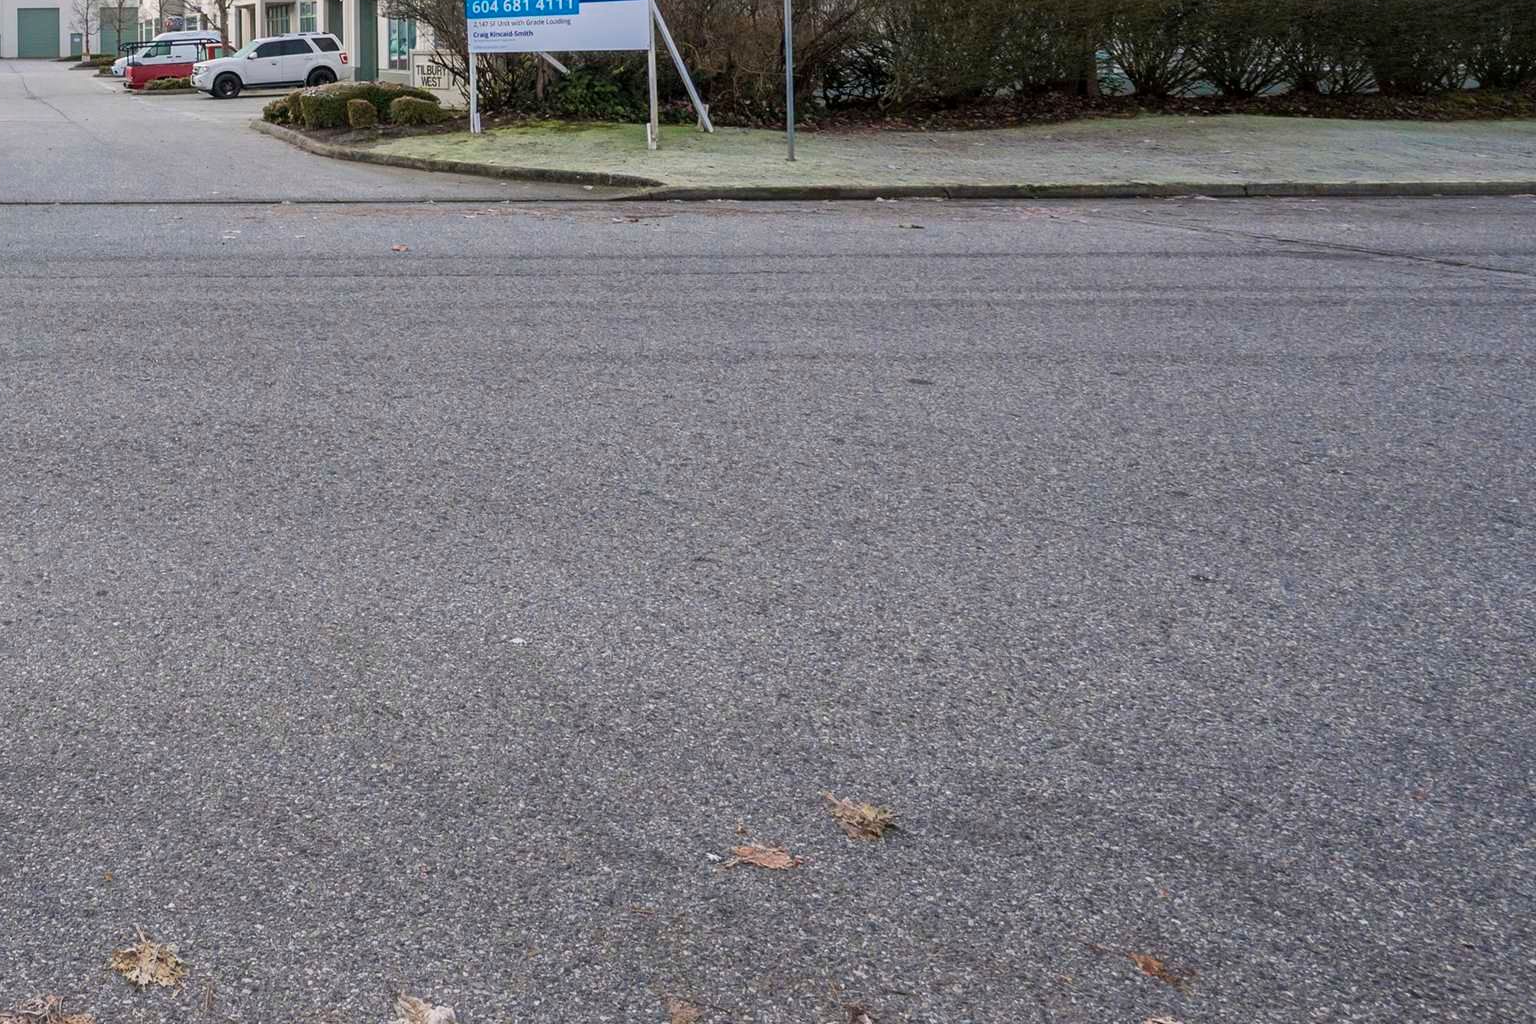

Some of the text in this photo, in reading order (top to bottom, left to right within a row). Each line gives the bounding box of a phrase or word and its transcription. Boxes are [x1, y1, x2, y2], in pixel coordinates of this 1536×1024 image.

[472, 0, 499, 14] 604
[526, 18, 545, 26] Grade
[546, 17, 572, 26] Loading
[473, 31, 489, 39] Craig
[416, 64, 447, 77] TILBURY
[421, 76, 442, 87] WEST
